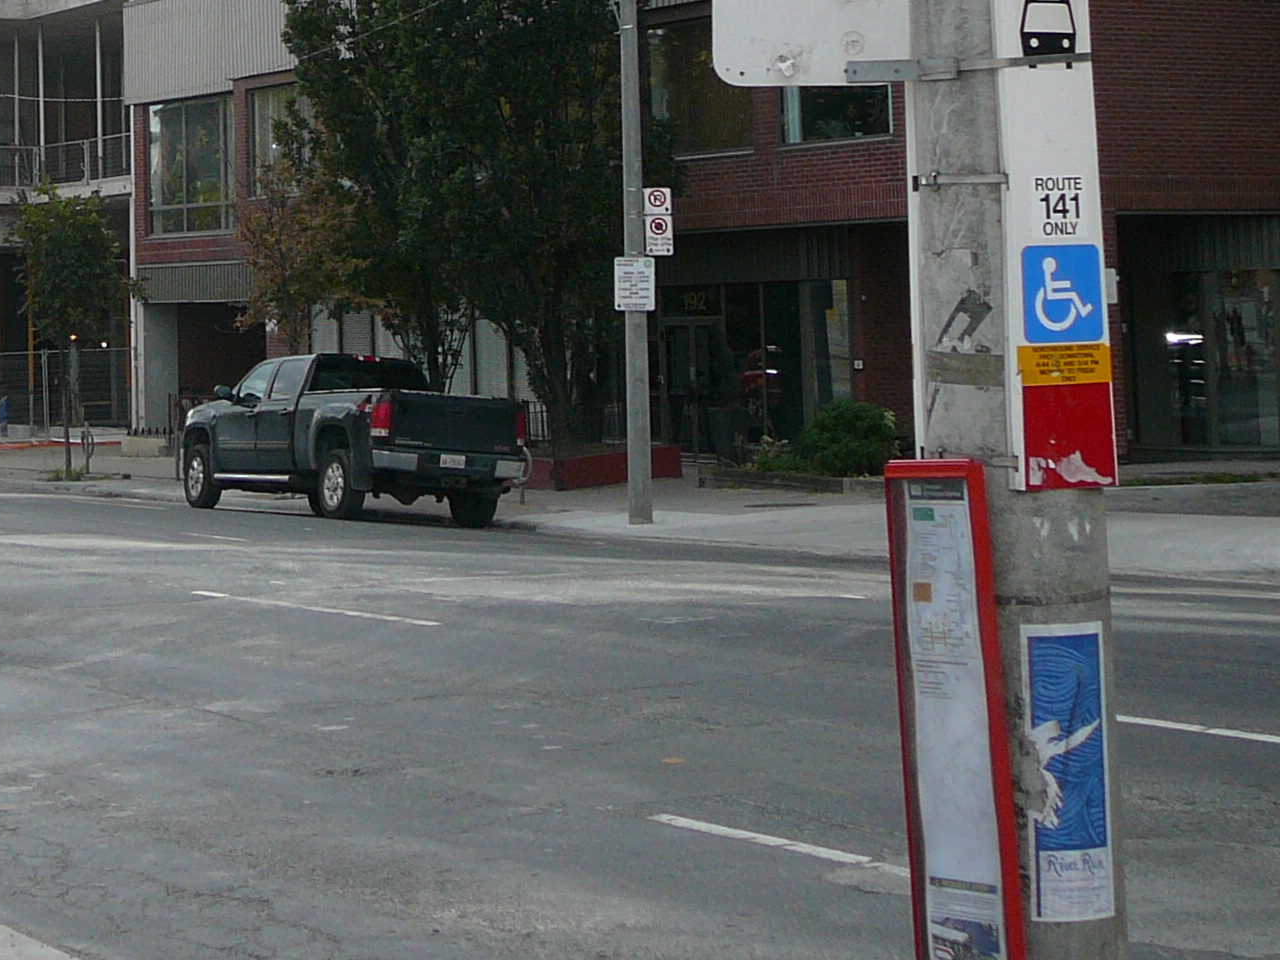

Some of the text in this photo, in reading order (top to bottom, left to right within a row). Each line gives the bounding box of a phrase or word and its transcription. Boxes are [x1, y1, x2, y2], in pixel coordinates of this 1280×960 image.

[1034, 176, 1083, 192] ROUTE
[1039, 192, 1081, 220] 141
[1042, 221, 1079, 237] ONLY
[681, 291, 707, 311] 192
